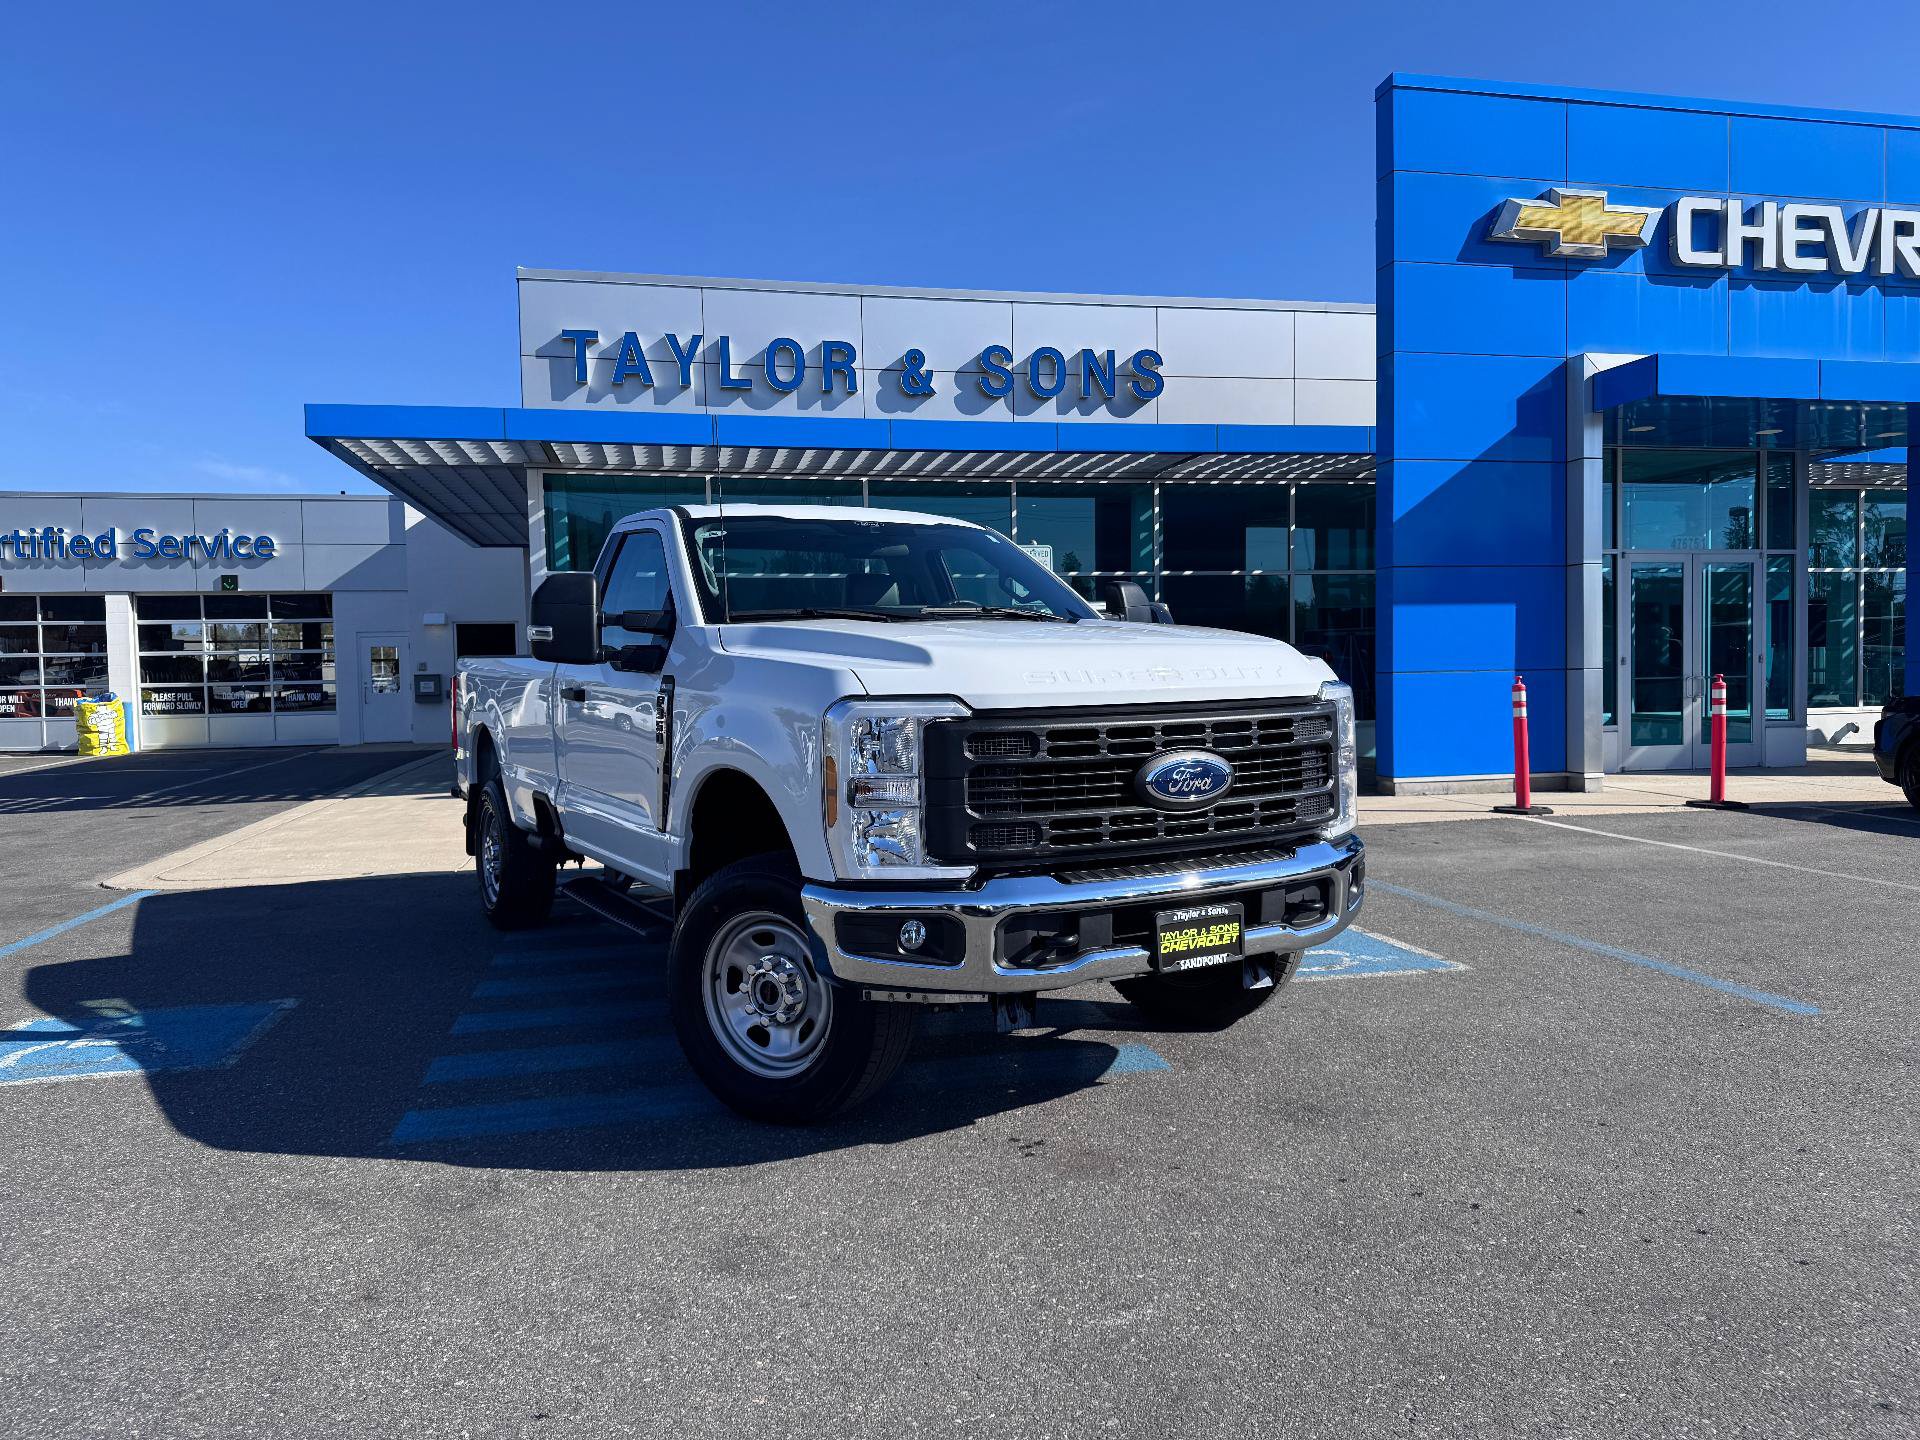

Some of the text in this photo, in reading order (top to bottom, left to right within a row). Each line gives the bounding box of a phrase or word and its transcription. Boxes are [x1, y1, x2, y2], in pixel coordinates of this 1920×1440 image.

[561, 329, 1165, 400] TAYLOR & SONS
[132, 528, 275, 559] Service
[8, 695, 24, 704] WILL
[151, 692, 193, 702] PLEASE PULL
[231, 700, 248, 709] OPEN
[285, 692, 321, 702] THANK YOU!
[143, 701, 202, 711] FORWARD SLOWLY
[1168, 767, 1214, 793] Ford
[1176, 910, 1200, 922] Taylor
[1207, 907, 1225, 916] Sons
[1160, 922, 1240, 943] TAYLOR & SONS
[1160, 932, 1240, 954] CHEVROLET
[1180, 953, 1229, 971] SANDPOINT
